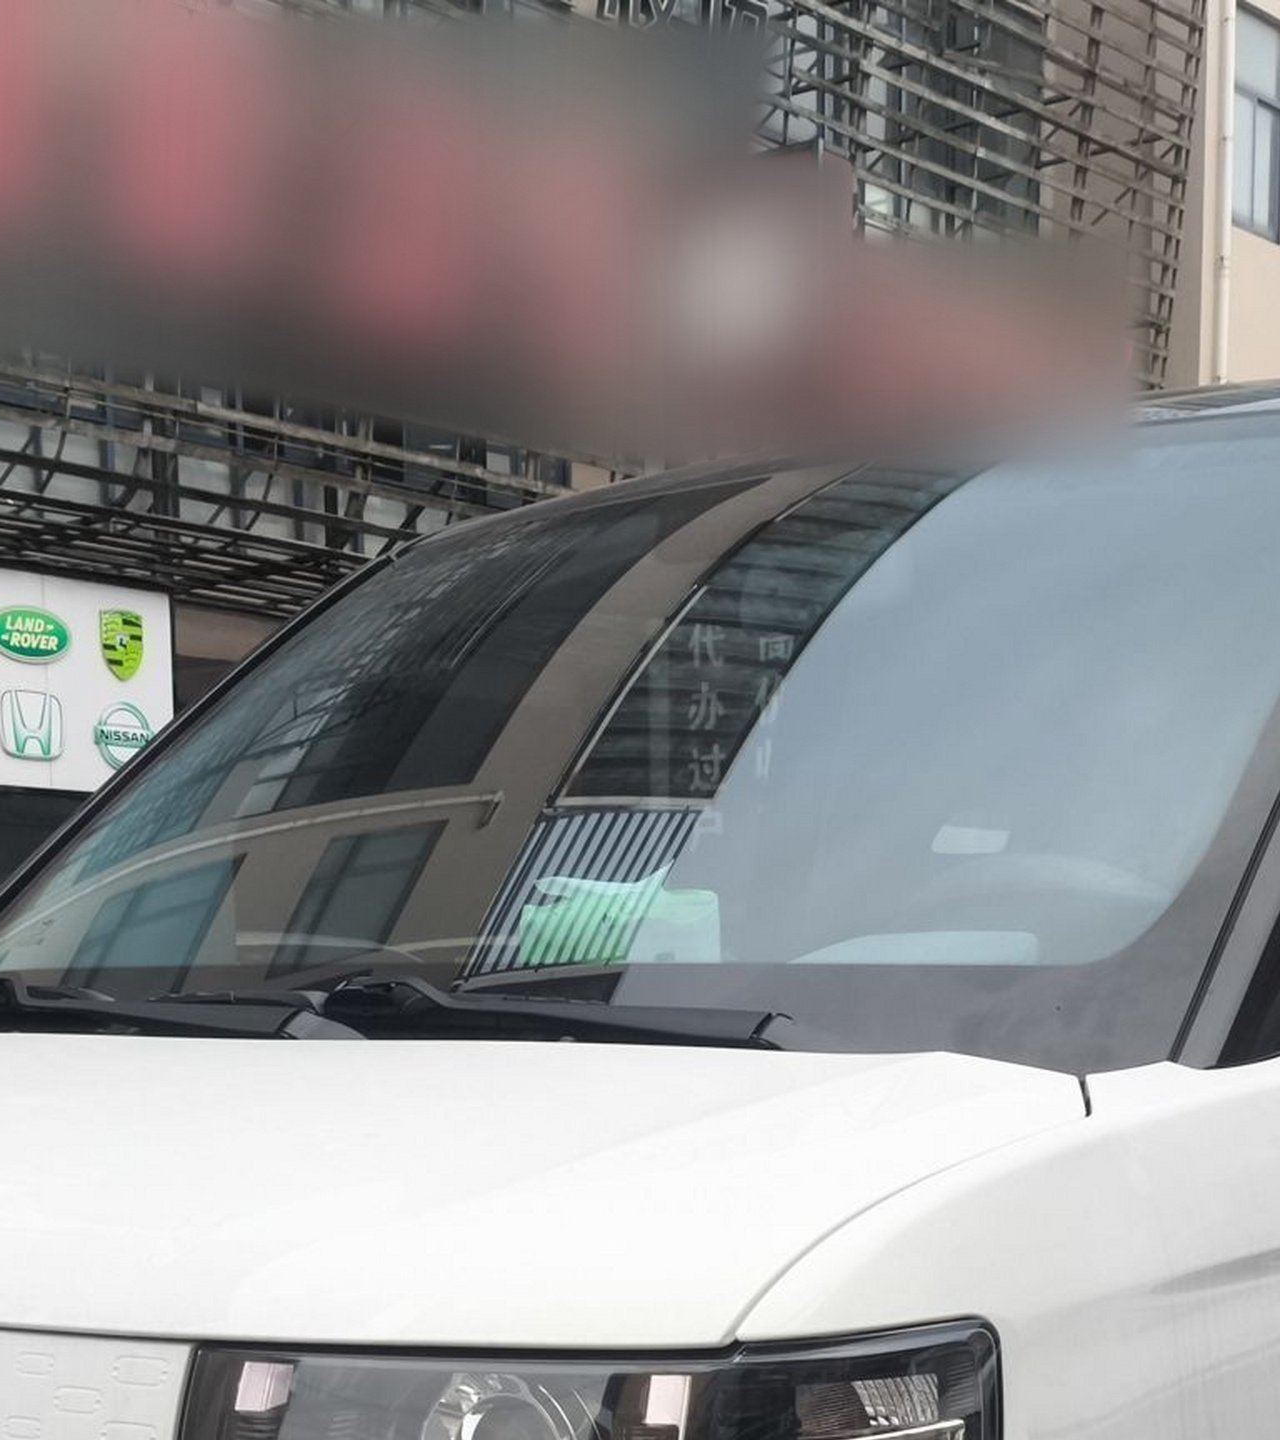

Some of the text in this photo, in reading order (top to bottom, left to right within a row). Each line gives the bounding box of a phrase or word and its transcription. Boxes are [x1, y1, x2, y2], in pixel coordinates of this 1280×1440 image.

[6, 615, 45, 632] LAND
[10, 632, 59, 651] ROVER
[99, 728, 150, 742] NISSAN
